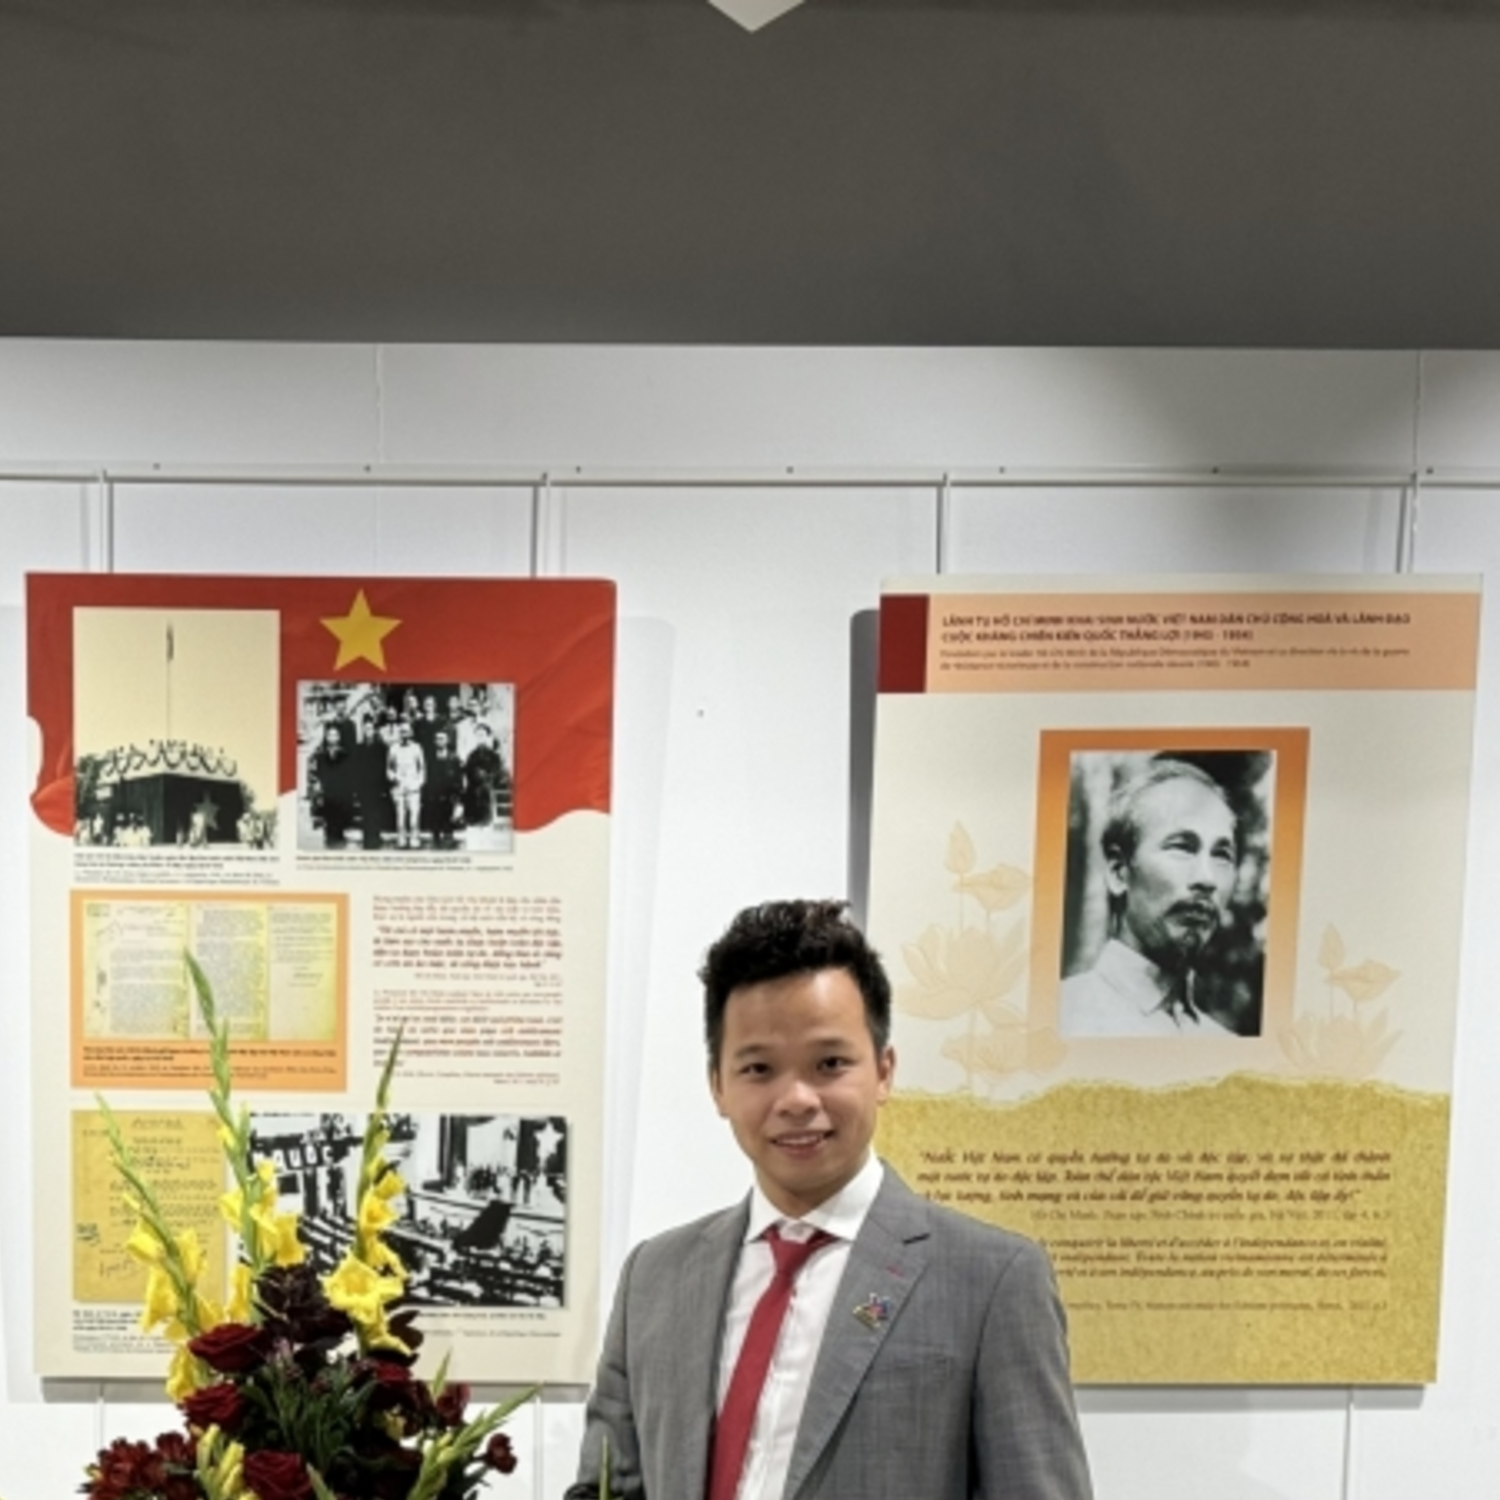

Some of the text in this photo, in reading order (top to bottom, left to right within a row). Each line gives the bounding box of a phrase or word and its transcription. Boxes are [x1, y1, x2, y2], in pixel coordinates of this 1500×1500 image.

[943, 613, 974, 627] LÃNH
[1189, 613, 1217, 624] NAM
[1083, 628, 1117, 642] QUỐC
